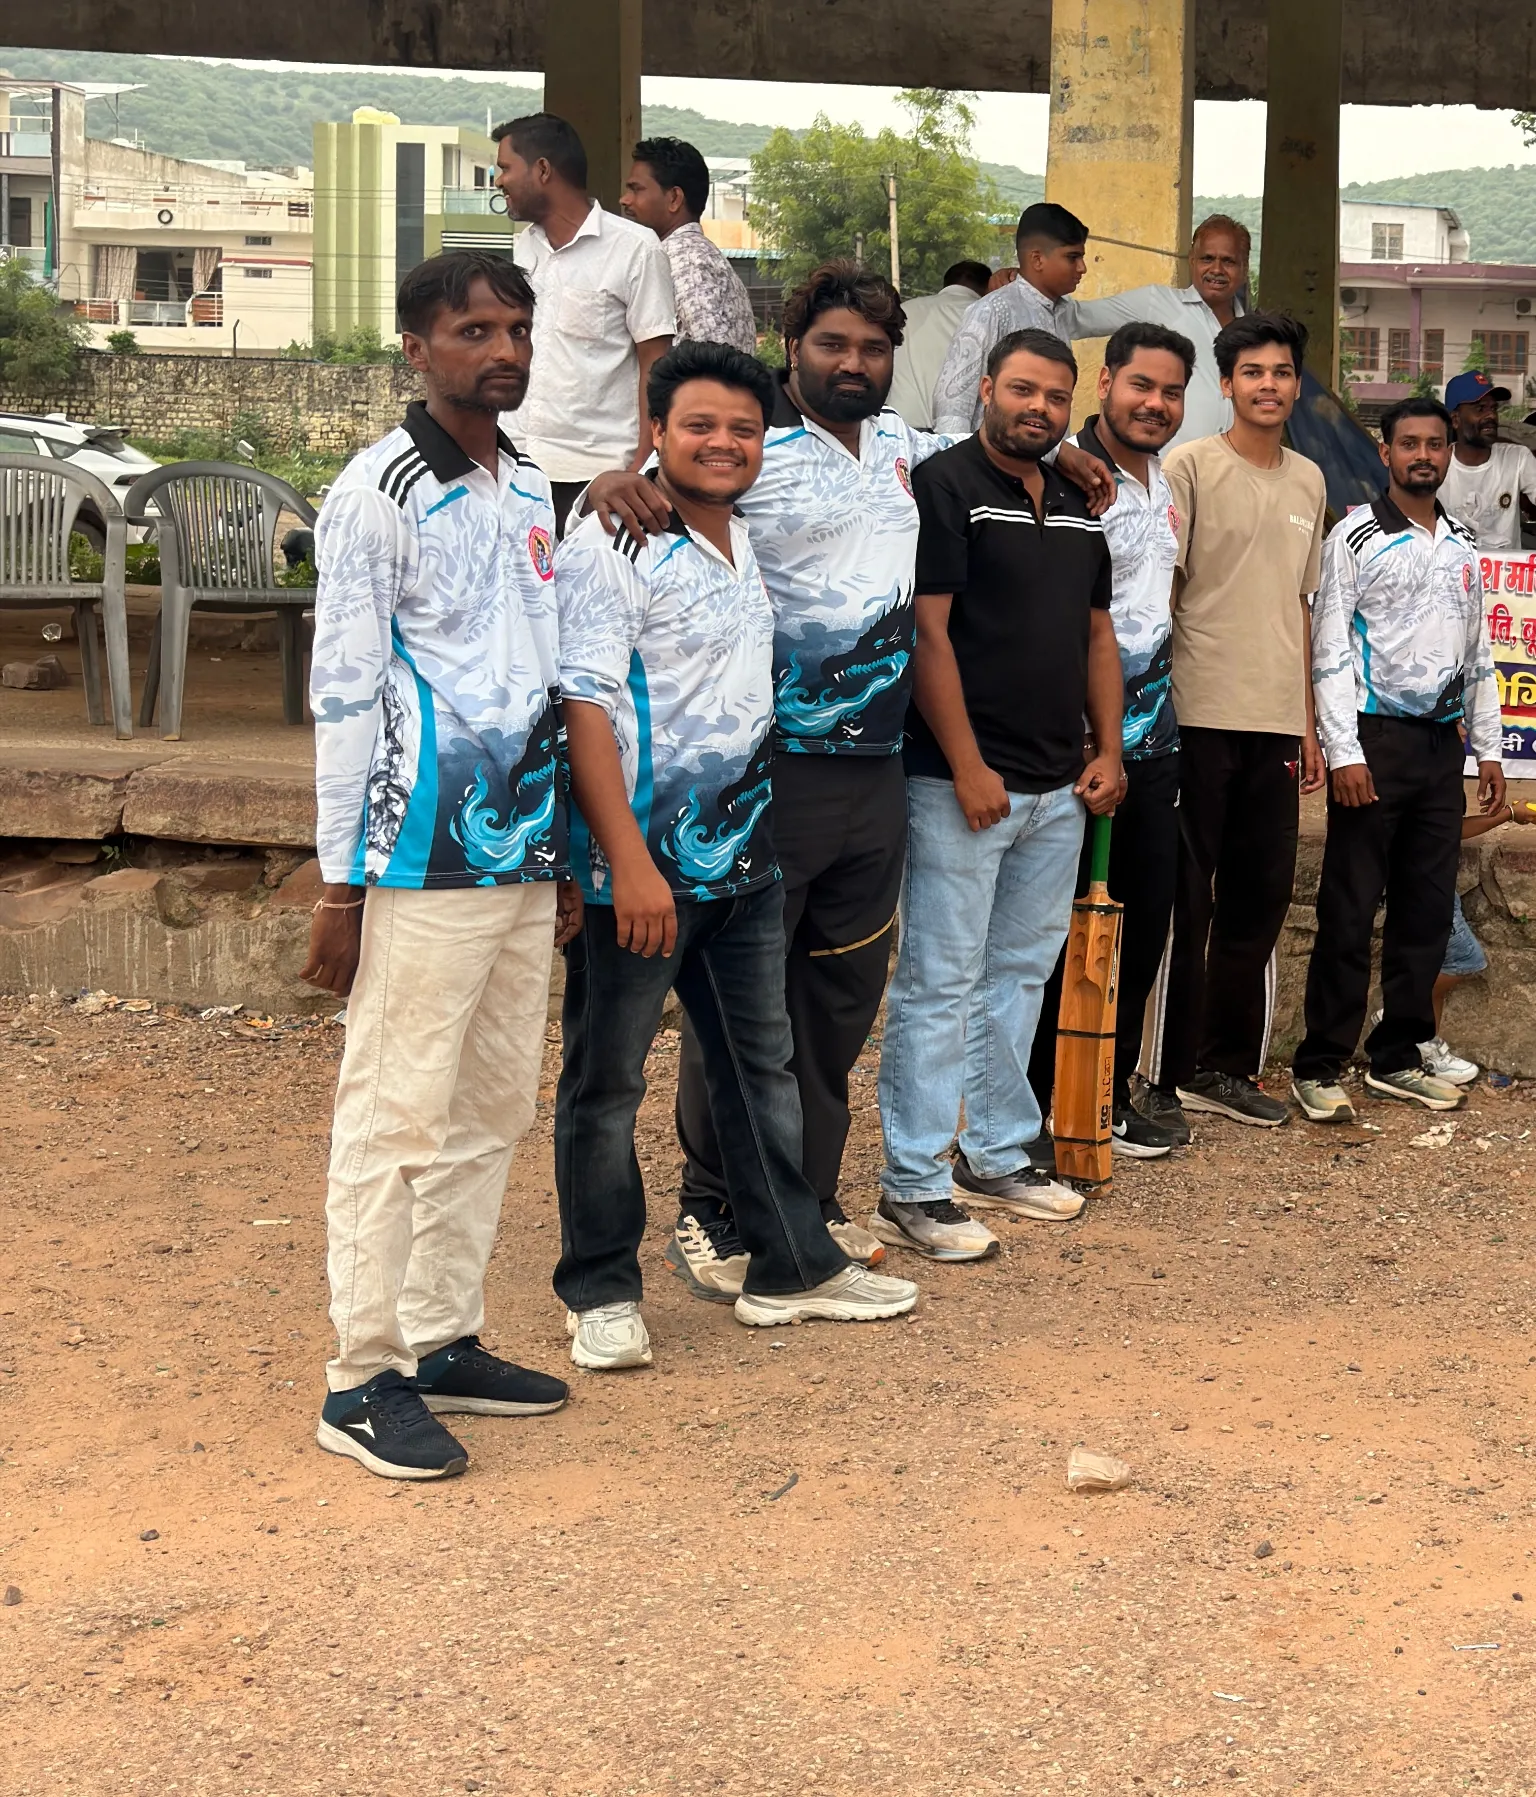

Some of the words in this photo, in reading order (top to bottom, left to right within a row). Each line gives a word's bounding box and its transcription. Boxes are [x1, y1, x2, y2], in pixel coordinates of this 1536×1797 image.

[1480, 557, 1502, 591] श
[1501, 732, 1524, 752] दी
[1100, 1104, 1109, 1130] KC
